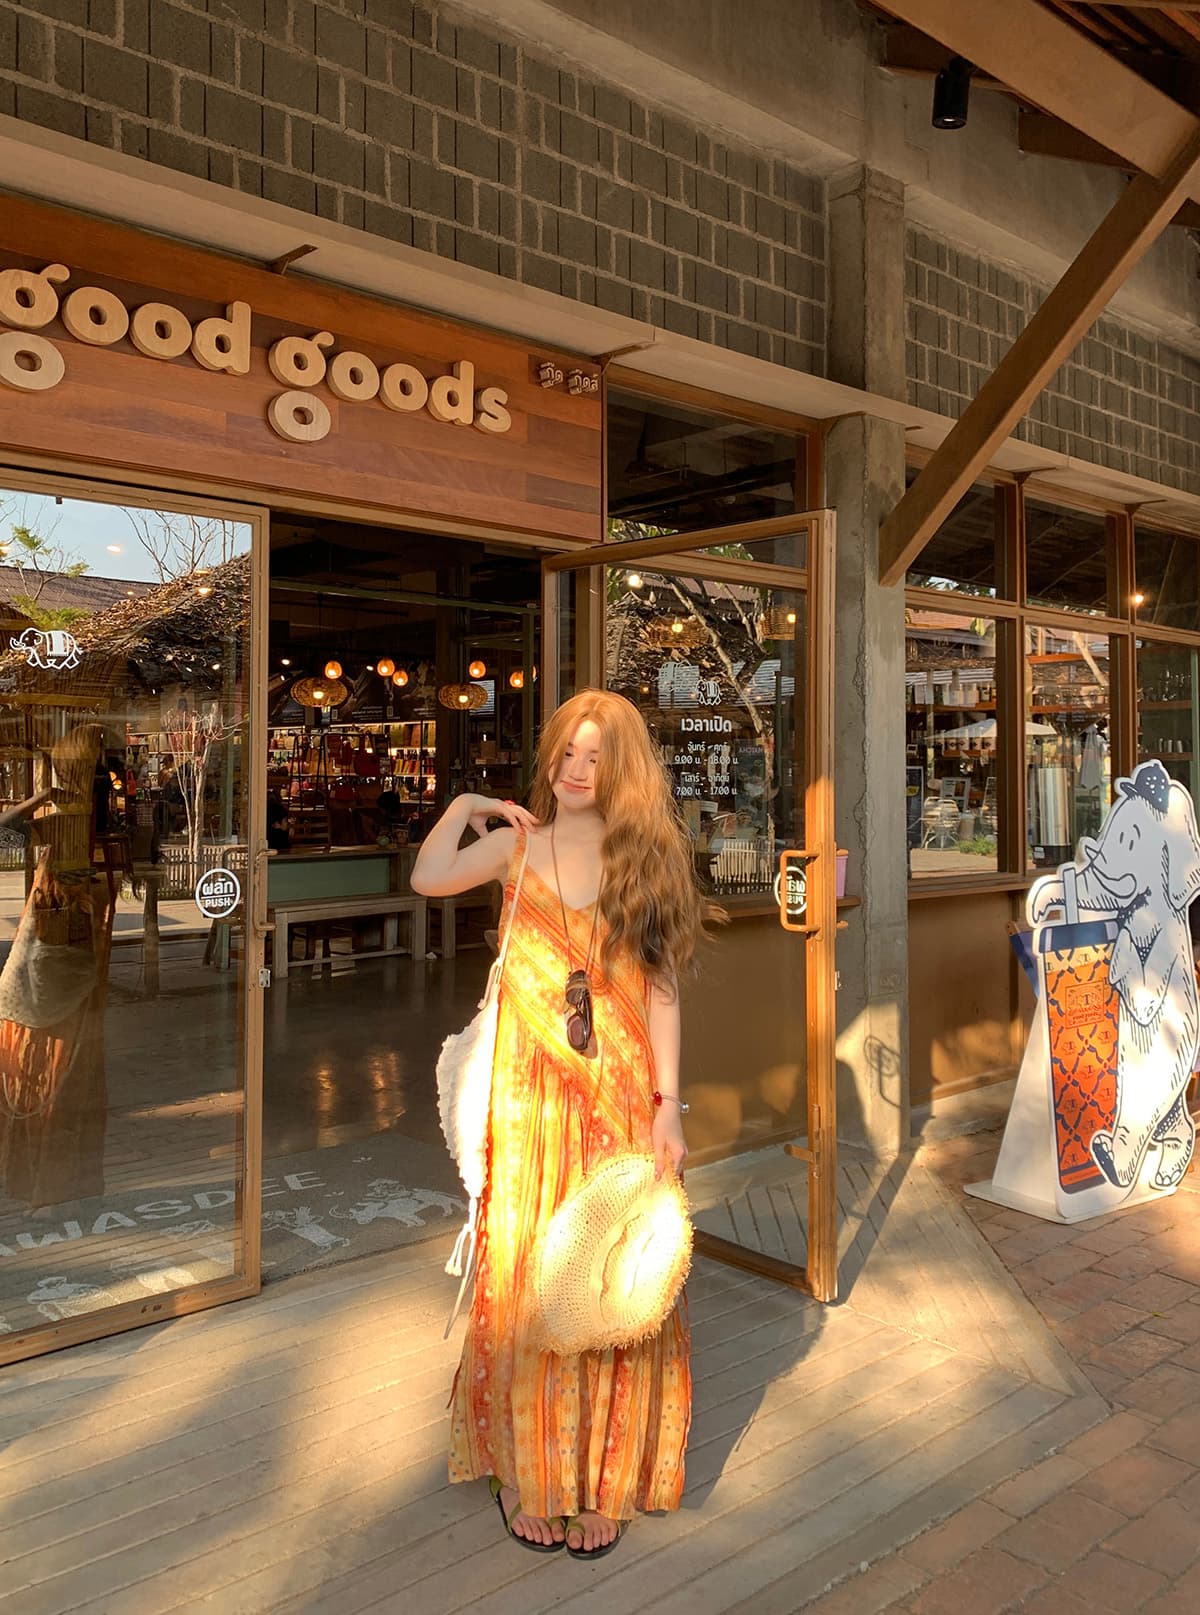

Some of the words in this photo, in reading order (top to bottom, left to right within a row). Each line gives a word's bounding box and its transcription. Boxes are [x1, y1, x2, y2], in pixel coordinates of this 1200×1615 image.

[0, 264, 251, 391] good
[268, 332, 512, 443] goods
[681, 716, 732, 732] เวลาเปิด
[202, 878, 233, 895] ผลัก
[205, 897, 230, 908] PUSH
